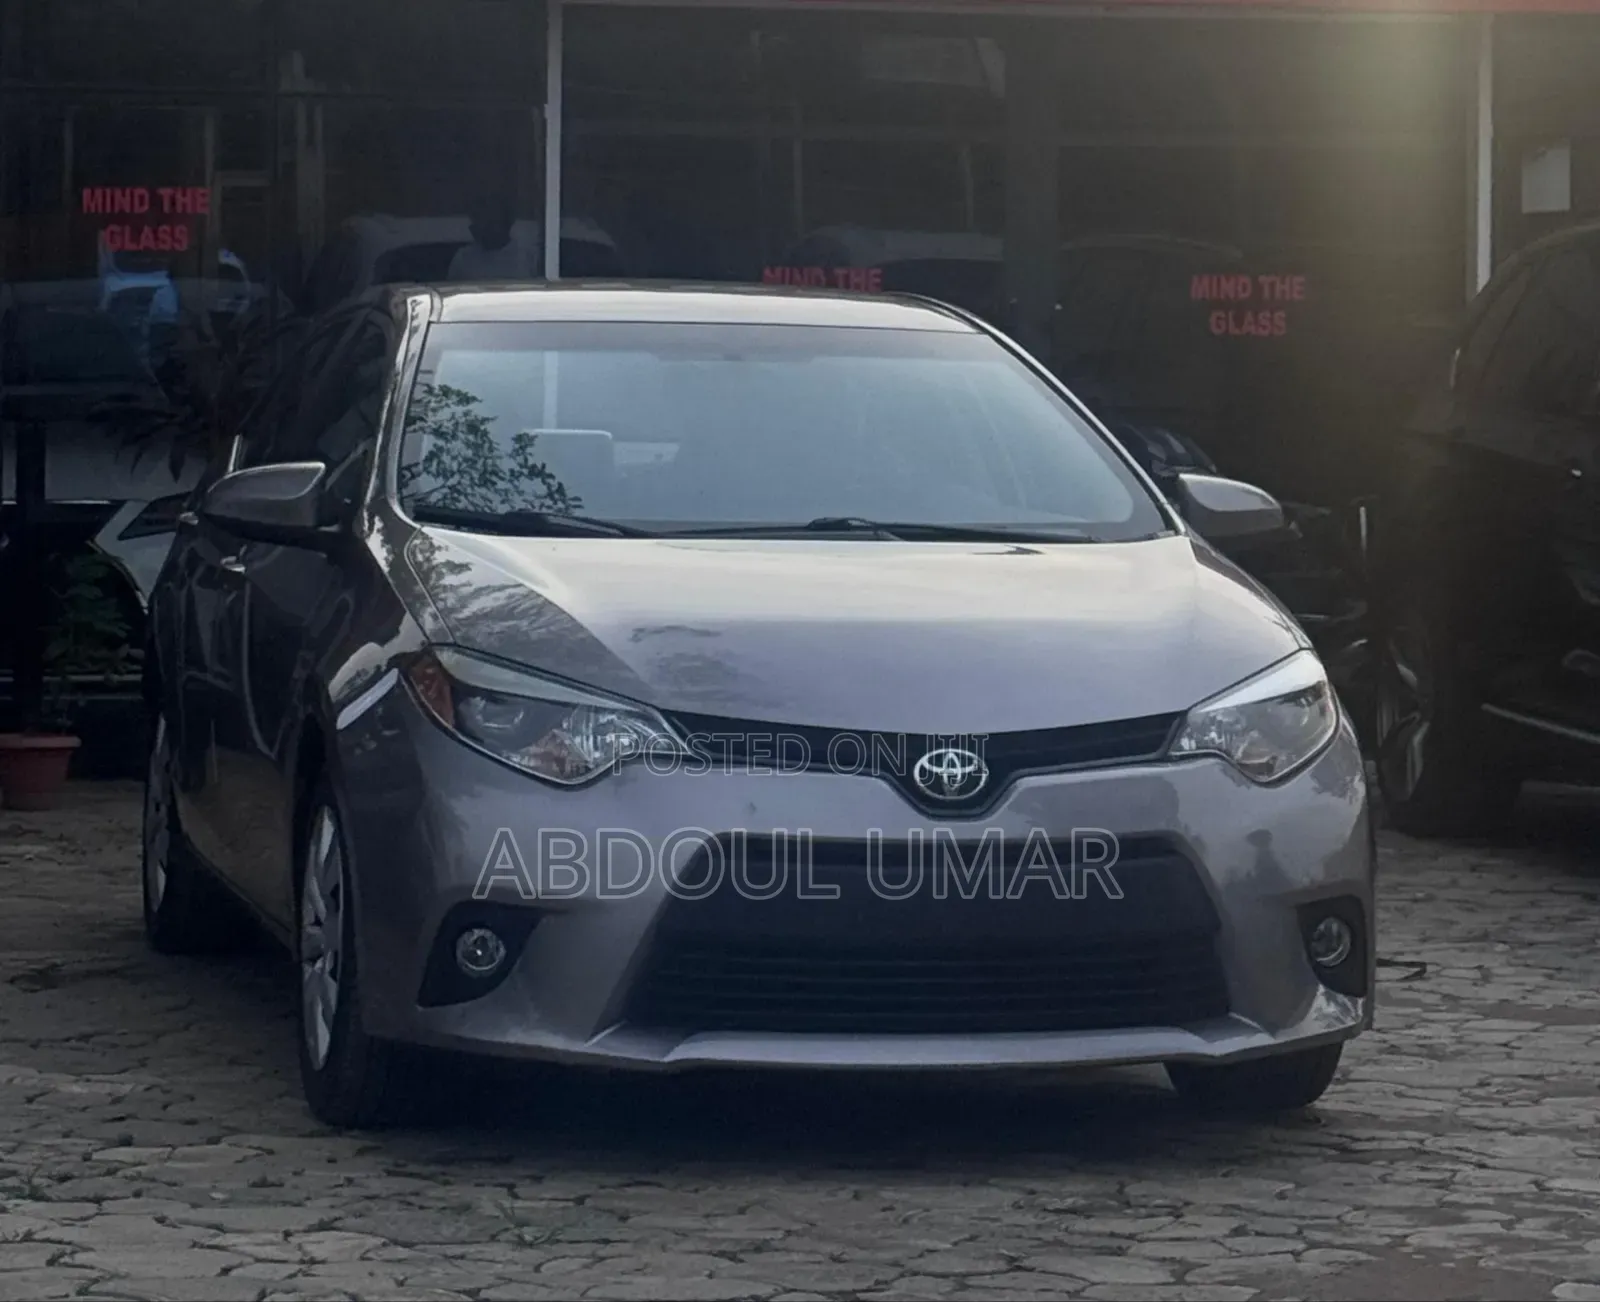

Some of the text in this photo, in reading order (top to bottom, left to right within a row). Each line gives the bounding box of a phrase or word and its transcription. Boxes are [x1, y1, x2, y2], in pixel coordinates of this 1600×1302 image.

[82, 186, 210, 214] MIND THE
[104, 223, 190, 252] GLASS
[763, 266, 883, 292] MIND THE
[1190, 274, 1306, 301] MIND THE
[1209, 309, 1287, 336] GLASS
